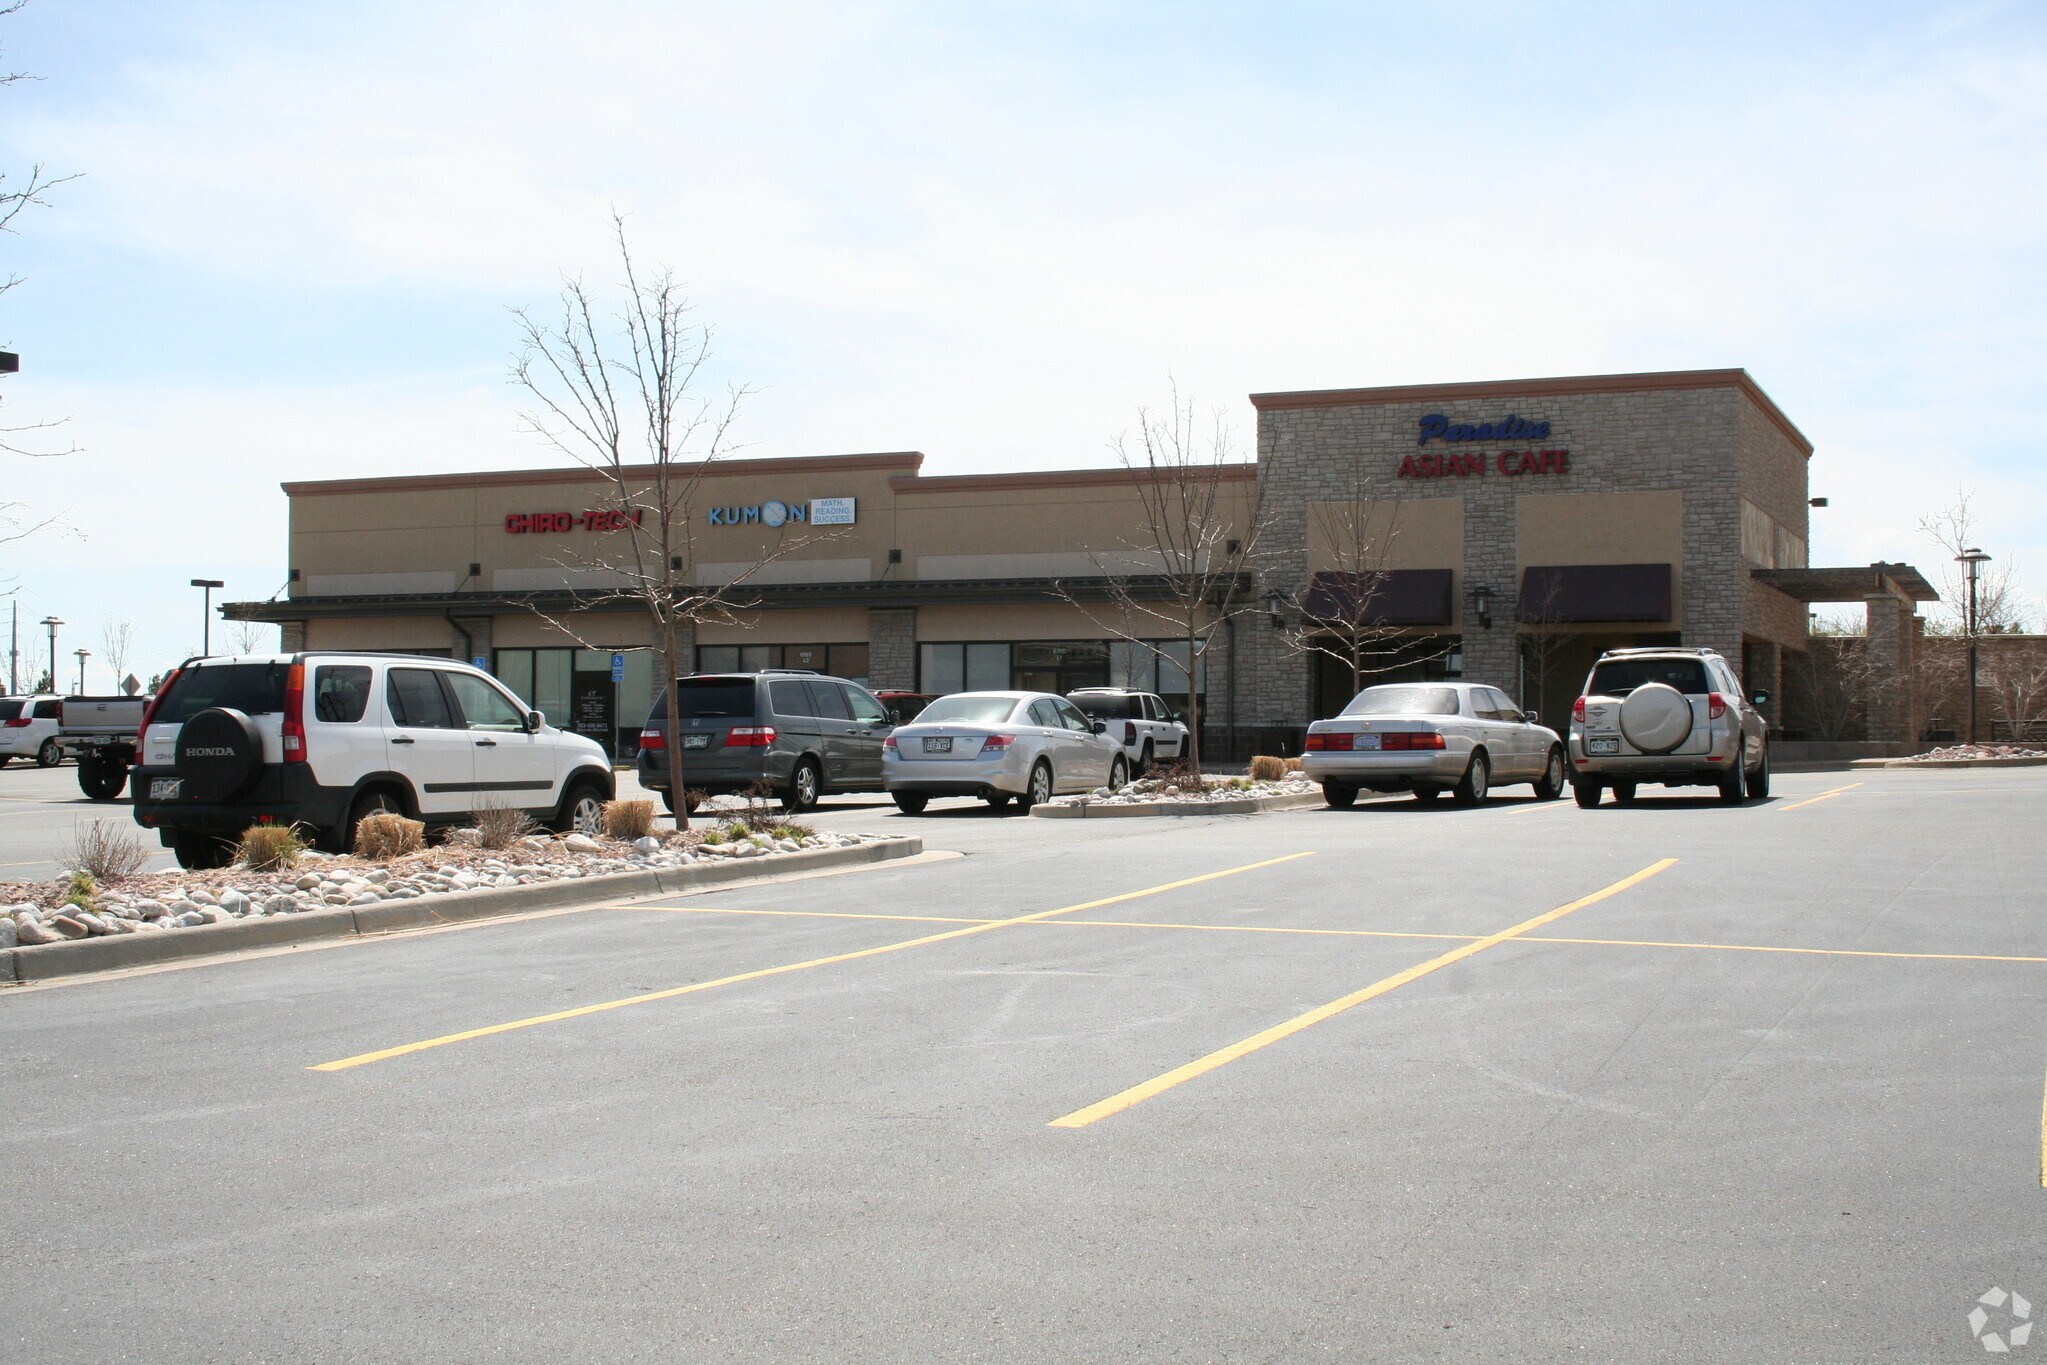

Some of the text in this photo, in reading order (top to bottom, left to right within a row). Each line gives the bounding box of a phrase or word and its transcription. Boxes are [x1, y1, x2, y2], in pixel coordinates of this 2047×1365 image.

[1417, 414, 1551, 447] Paradise
[1397, 450, 1570, 479] ASIAN CAFE
[708, 499, 807, 528] KUMON
[185, 747, 236, 757] HONDA
